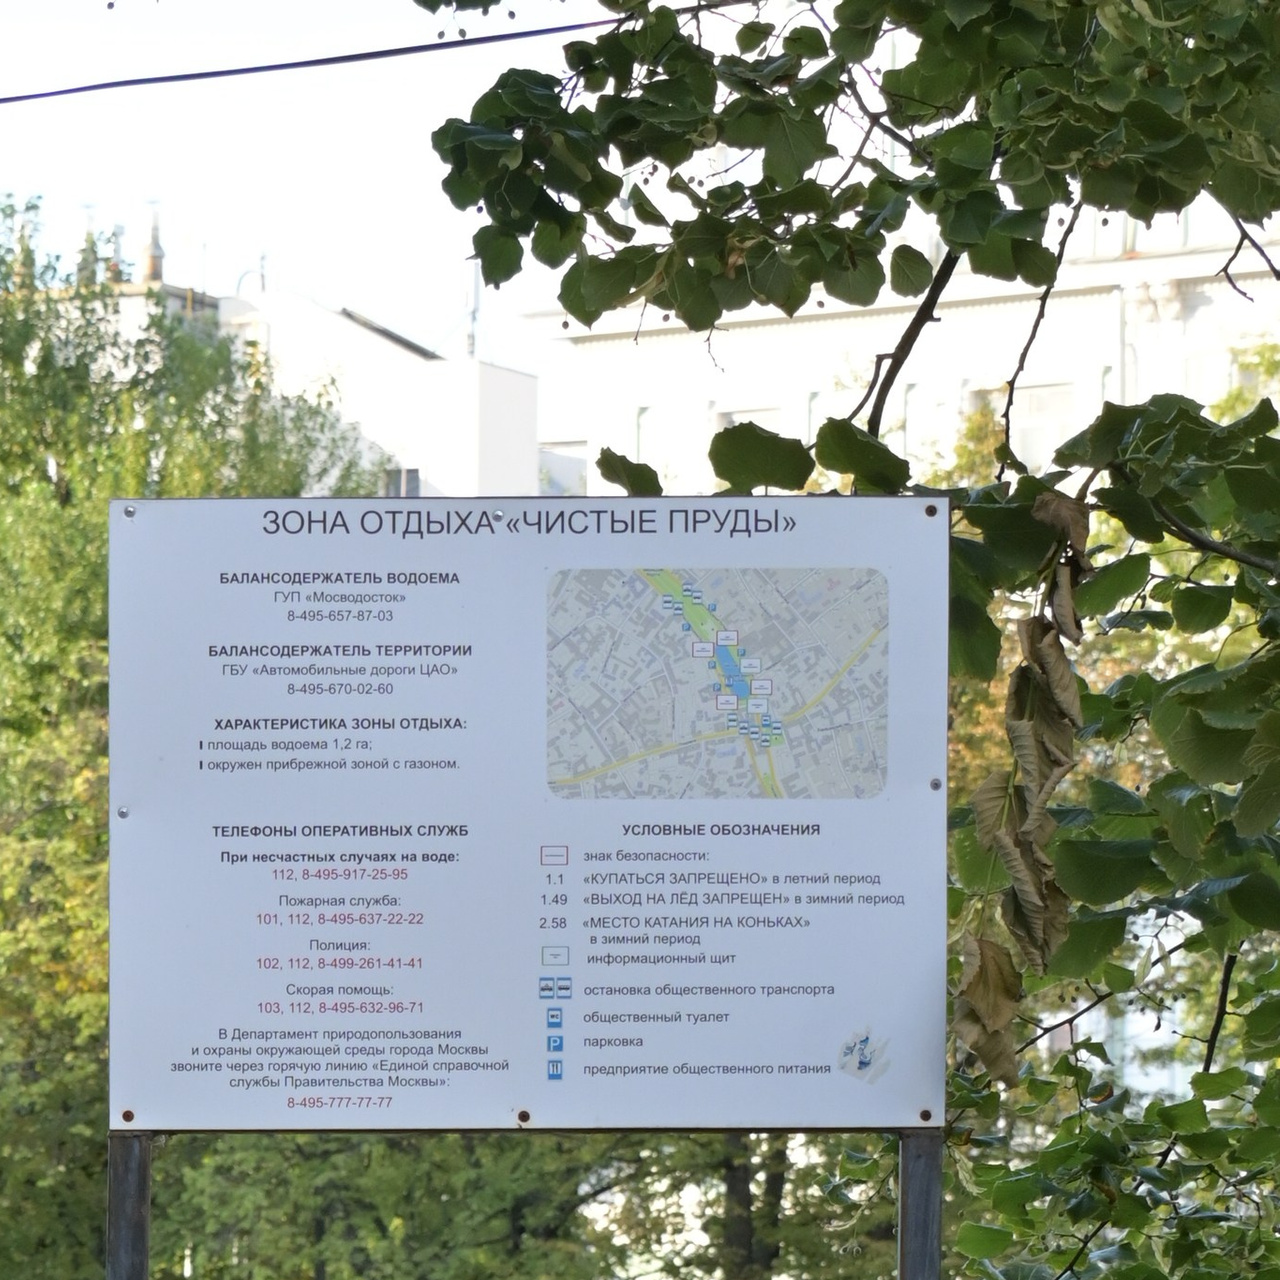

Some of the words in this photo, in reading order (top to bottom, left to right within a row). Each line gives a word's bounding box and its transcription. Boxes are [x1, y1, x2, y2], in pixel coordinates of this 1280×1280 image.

[262, 509, 351, 535] ЗОНА
[359, 509, 495, 540] ОТДЫХА
[505, 509, 658, 535] «ЧИСТЫЕ
[669, 508, 797, 539] ПРУДЫ»
[219, 572, 383, 587] БАЛАНСОДЕРЖАТЕЛЬ
[386, 572, 461, 587] ВОДОЕМА
[274, 590, 301, 603] ГУП
[305, 590, 406, 605] «Мосводосток»
[287, 609, 394, 622] 8-495-657-87-03
[208, 644, 372, 659] БАЛАНСОДЕРЖАТЕЛЬ
[374, 644, 473, 657] ТЕРРИТОРИИ
[222, 663, 249, 676] ГБУ
[252, 663, 367, 676] «Автомобильные
[369, 666, 416, 678] дороги
[419, 663, 458, 678] ЦАО»
[287, 682, 394, 696] 8-495-670-02-60
[214, 717, 348, 731] ХАРАКТЕРИСТИКА
[351, 717, 396, 730] ЗОНЫ
[399, 717, 467, 732] ОТДЫХА:
[207, 740, 268, 753] площадь
[271, 740, 328, 752] водоема
[332, 737, 352, 751] 1,2
[355, 740, 372, 751] га;
[207, 760, 263, 774] окружен
[266, 757, 347, 773] прибрежной
[350, 757, 389, 770] зоной
[392, 760, 401, 770] с
[404, 759, 460, 770] газоном.
[211, 825, 297, 838] ТЕЛЕФОНЫ
[301, 824, 413, 838] ОПЕРАТИВНЫХ
[416, 824, 469, 837] СЛУЖБ
[621, 823, 706, 837] УСЛОВНЫЕ
[709, 823, 821, 836] ОБОЗНАЧЕНИЯ
[220, 850, 248, 866] При
[252, 853, 336, 863] несчастных
[339, 852, 397, 866] случаях
[400, 852, 418, 863] на
[421, 852, 460, 864] воде:
[583, 852, 613, 862] знак
[615, 849, 710, 862] безопасности:
[272, 868, 298, 882] 112,
[301, 868, 409, 881] 8-495-917-25-95
[546, 873, 564, 885] 1.1
[583, 872, 665, 885] «КУПАТЬСЯ
[669, 872, 768, 887] ЗАПРЕЩЕНО»
[772, 875, 780, 885] в
[783, 872, 830, 885] летний
[833, 874, 882, 887] период
[278, 894, 346, 910] Пожарная
[349, 894, 402, 910] служба:
[540, 893, 568, 906] 1.49
[583, 892, 643, 907] «ВЫХОД
[646, 892, 667, 905] НА
[669, 890, 699, 907] ЛЁД
[702, 892, 790, 907] ЗАПРЕЩЕН»
[794, 895, 802, 905] в
[805, 892, 854, 905] зимний
[857, 894, 906, 907] период
[256, 913, 283, 927] 101,
[287, 912, 314, 927] 112,
[317, 912, 424, 925] 8-495-637-22-22
[539, 916, 567, 930] 2.58
[582, 916, 641, 929] «МЕСТО
[644, 916, 710, 929] КАТАНИЯ
[713, 916, 734, 928] НА
[737, 915, 811, 929] КОНЬКАХ»
[309, 938, 371, 953] Полиция:
[589, 935, 598, 945] в
[601, 932, 650, 945] зимний
[653, 935, 701, 947] период
[256, 957, 283, 971] 102,
[288, 957, 314, 971] 112,
[317, 957, 422, 970] 8-499-261-41-41
[587, 952, 706, 967] информационный
[710, 954, 737, 966] щит
[285, 983, 334, 998] Скорая
[337, 985, 394, 997] помощь:
[583, 986, 652, 996] остановка
[654, 983, 757, 997] общественного
[759, 985, 835, 998] транспорта
[257, 1001, 284, 1015] 103,
[289, 1001, 315, 1015] 112,
[318, 1001, 423, 1014] 8-495-632-96-71
[583, 1010, 682, 1025] общественный
[685, 1013, 731, 1026] туалет
[218, 1027, 228, 1040] В
[230, 1027, 319, 1043] Департамент
[322, 1030, 462, 1043] природопользования
[191, 1046, 200, 1056] и
[202, 1046, 252, 1059] охраны
[255, 1043, 341, 1059] окружающей
[344, 1046, 386, 1058] среды
[389, 1045, 434, 1058] города
[437, 1043, 489, 1056] Москвы
[583, 1037, 644, 1050] парковка
[170, 1062, 223, 1073] звоните
[226, 1062, 264, 1075] через
[267, 1062, 322, 1075] горячую
[324, 1062, 368, 1072] линию
[372, 1059, 429, 1073] «Единой
[432, 1059, 510, 1074] справочной
[583, 1065, 669, 1078] предприятие
[672, 1062, 774, 1076] общественного
[777, 1064, 832, 1075] питания
[229, 1075, 281, 1091] службы
[284, 1075, 384, 1090] Правительства
[387, 1075, 450, 1088] Москвы»:
[286, 1096, 393, 1109] 8-495-777-77-77
